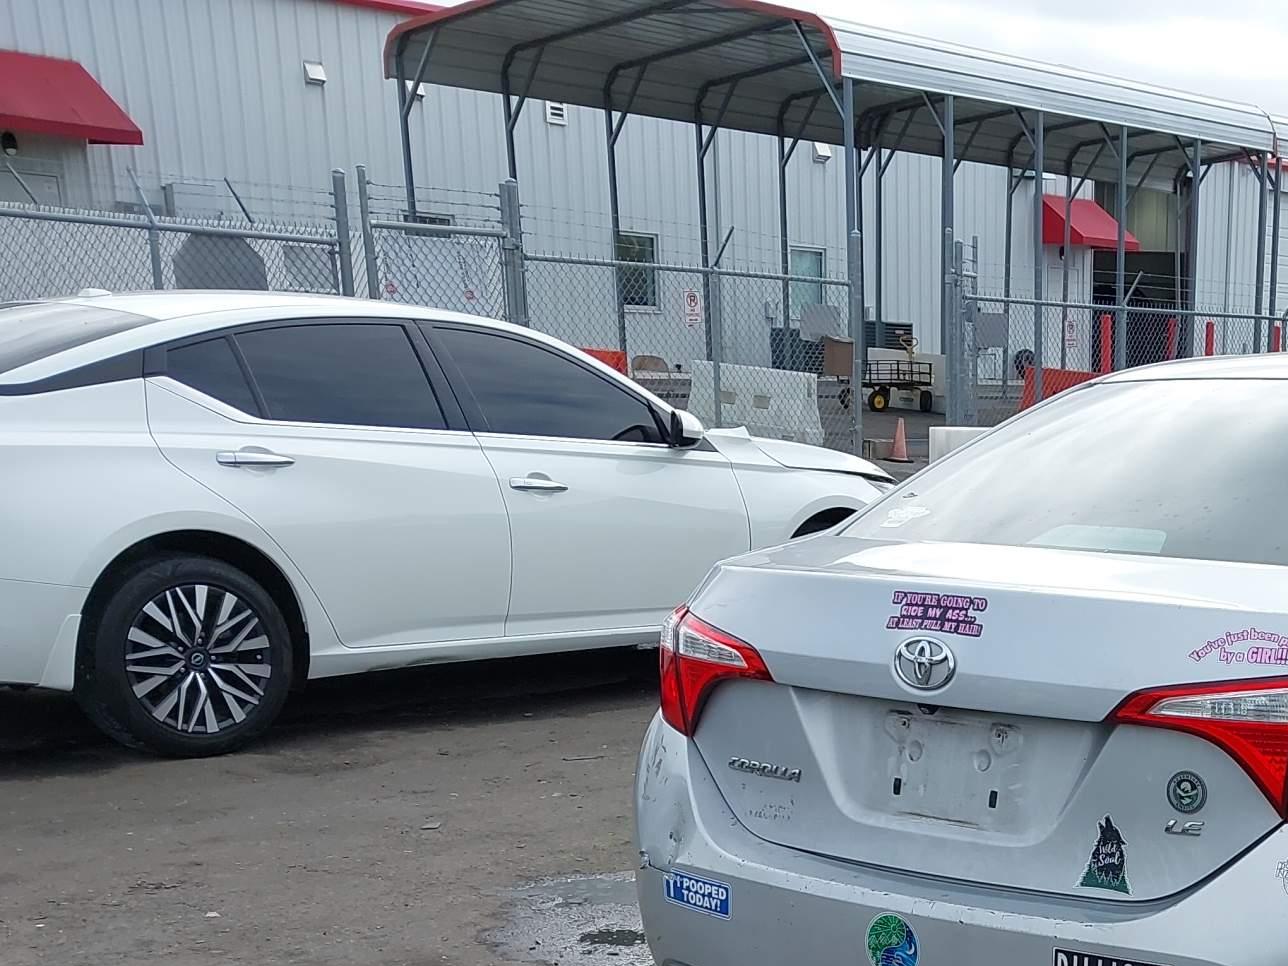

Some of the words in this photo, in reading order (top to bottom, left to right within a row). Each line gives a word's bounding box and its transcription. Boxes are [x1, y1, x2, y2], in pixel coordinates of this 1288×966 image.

[894, 592, 905, 603] IF
[905, 593, 938, 605] YOU'RE
[940, 597, 970, 609] GOING
[973, 600, 986, 610] TO
[901, 606, 924, 616] RIDE
[927, 608, 943, 618] MY
[887, 617, 898, 628] AT
[898, 618, 920, 629] LEAST
[921, 620, 941, 630] PULL
[942, 622, 959, 632] MY
[1225, 629, 1249, 646] just
[1249, 627, 1280, 643] been
[1219, 647, 1235, 664] by
[1235, 652, 1245, 662] a
[1164, 819, 1205, 836] LE
[683, 877, 727, 900] POOPED
[682, 889, 721, 911] TODAY!
